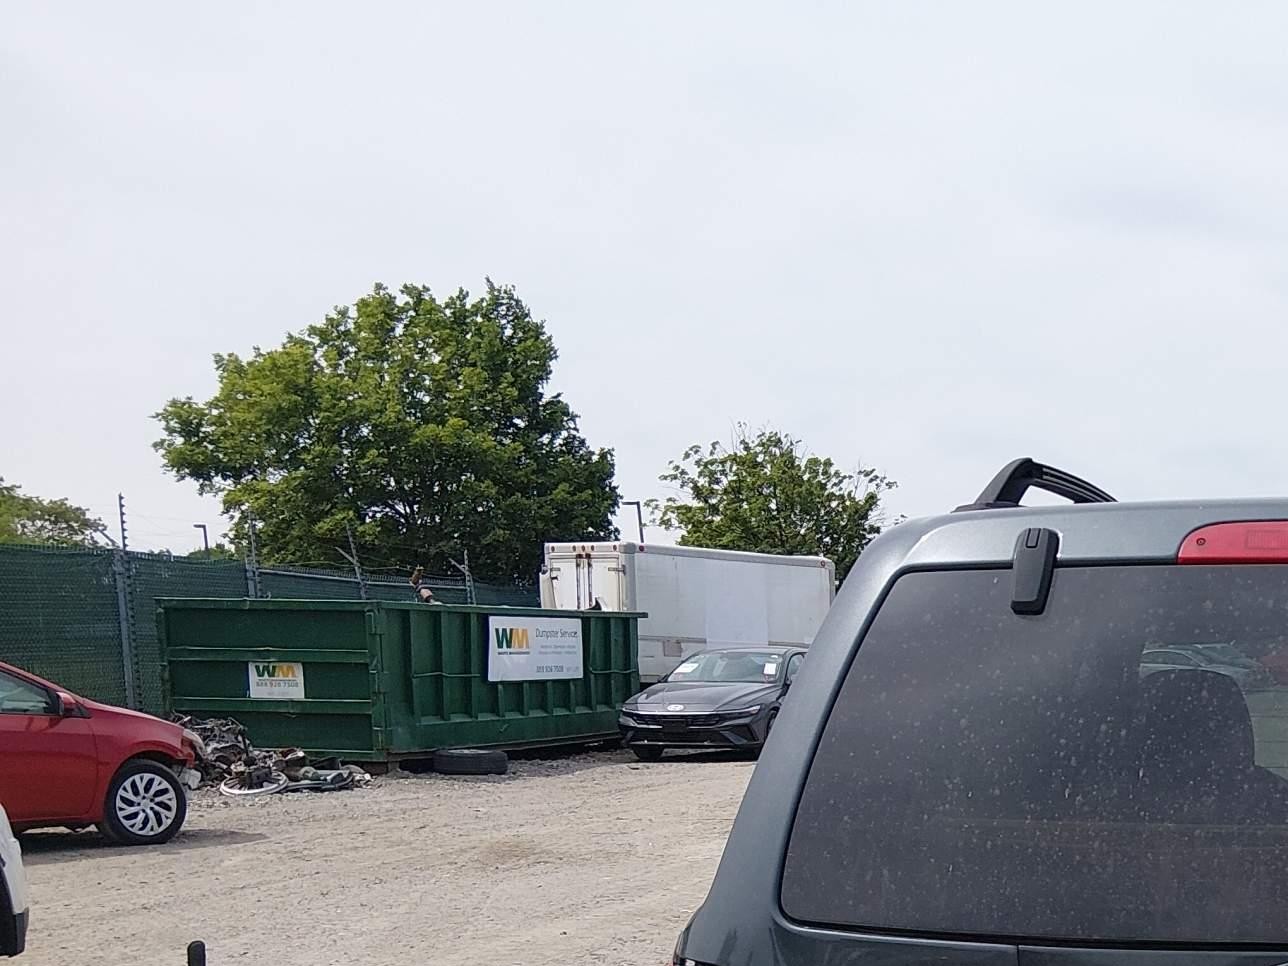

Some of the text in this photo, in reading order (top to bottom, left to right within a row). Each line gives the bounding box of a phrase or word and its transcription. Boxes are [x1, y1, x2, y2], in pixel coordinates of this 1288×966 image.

[495, 627, 530, 649] WM
[535, 628, 578, 640] Dumpster Service
[254, 664, 297, 677] WM
